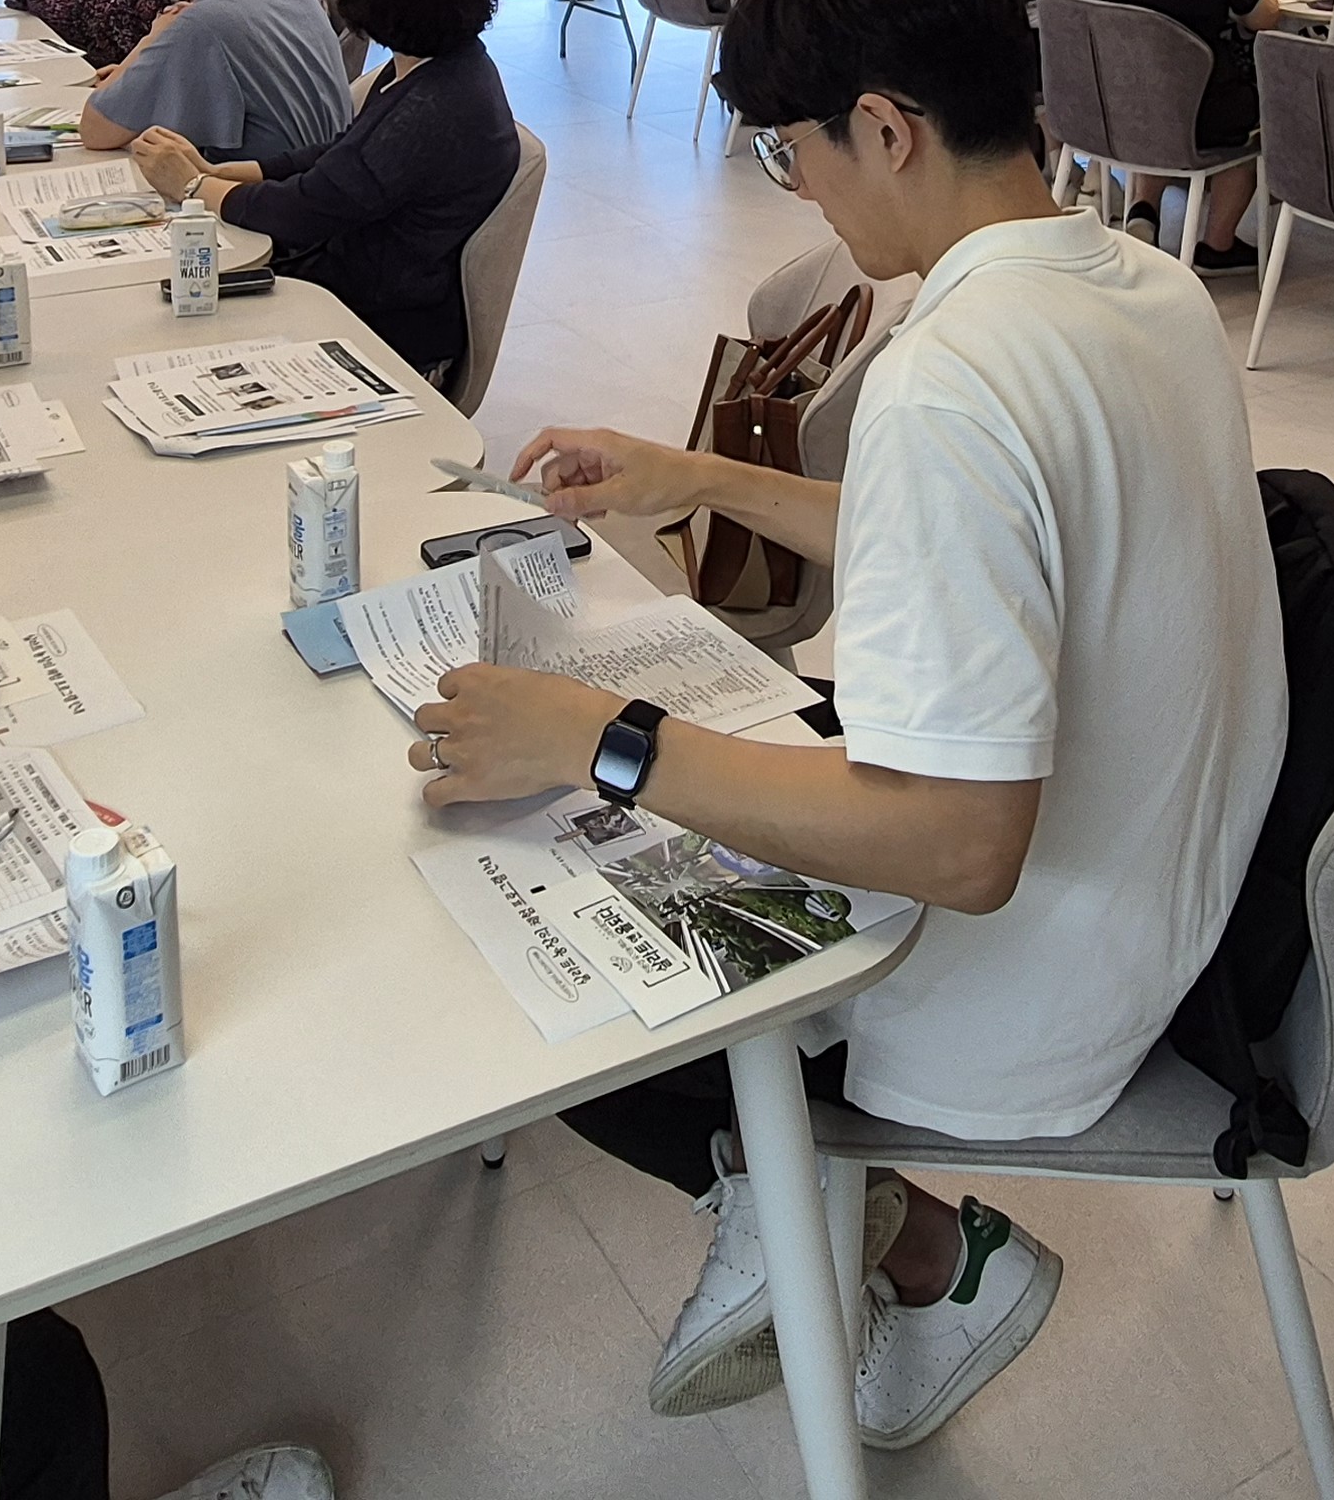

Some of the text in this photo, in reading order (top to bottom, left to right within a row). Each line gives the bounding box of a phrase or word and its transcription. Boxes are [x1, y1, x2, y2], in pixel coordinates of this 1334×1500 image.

[180, 266, 210, 279] WATER
[597, 904, 635, 935] 올되다
[634, 941, 673, 972] 살라트
